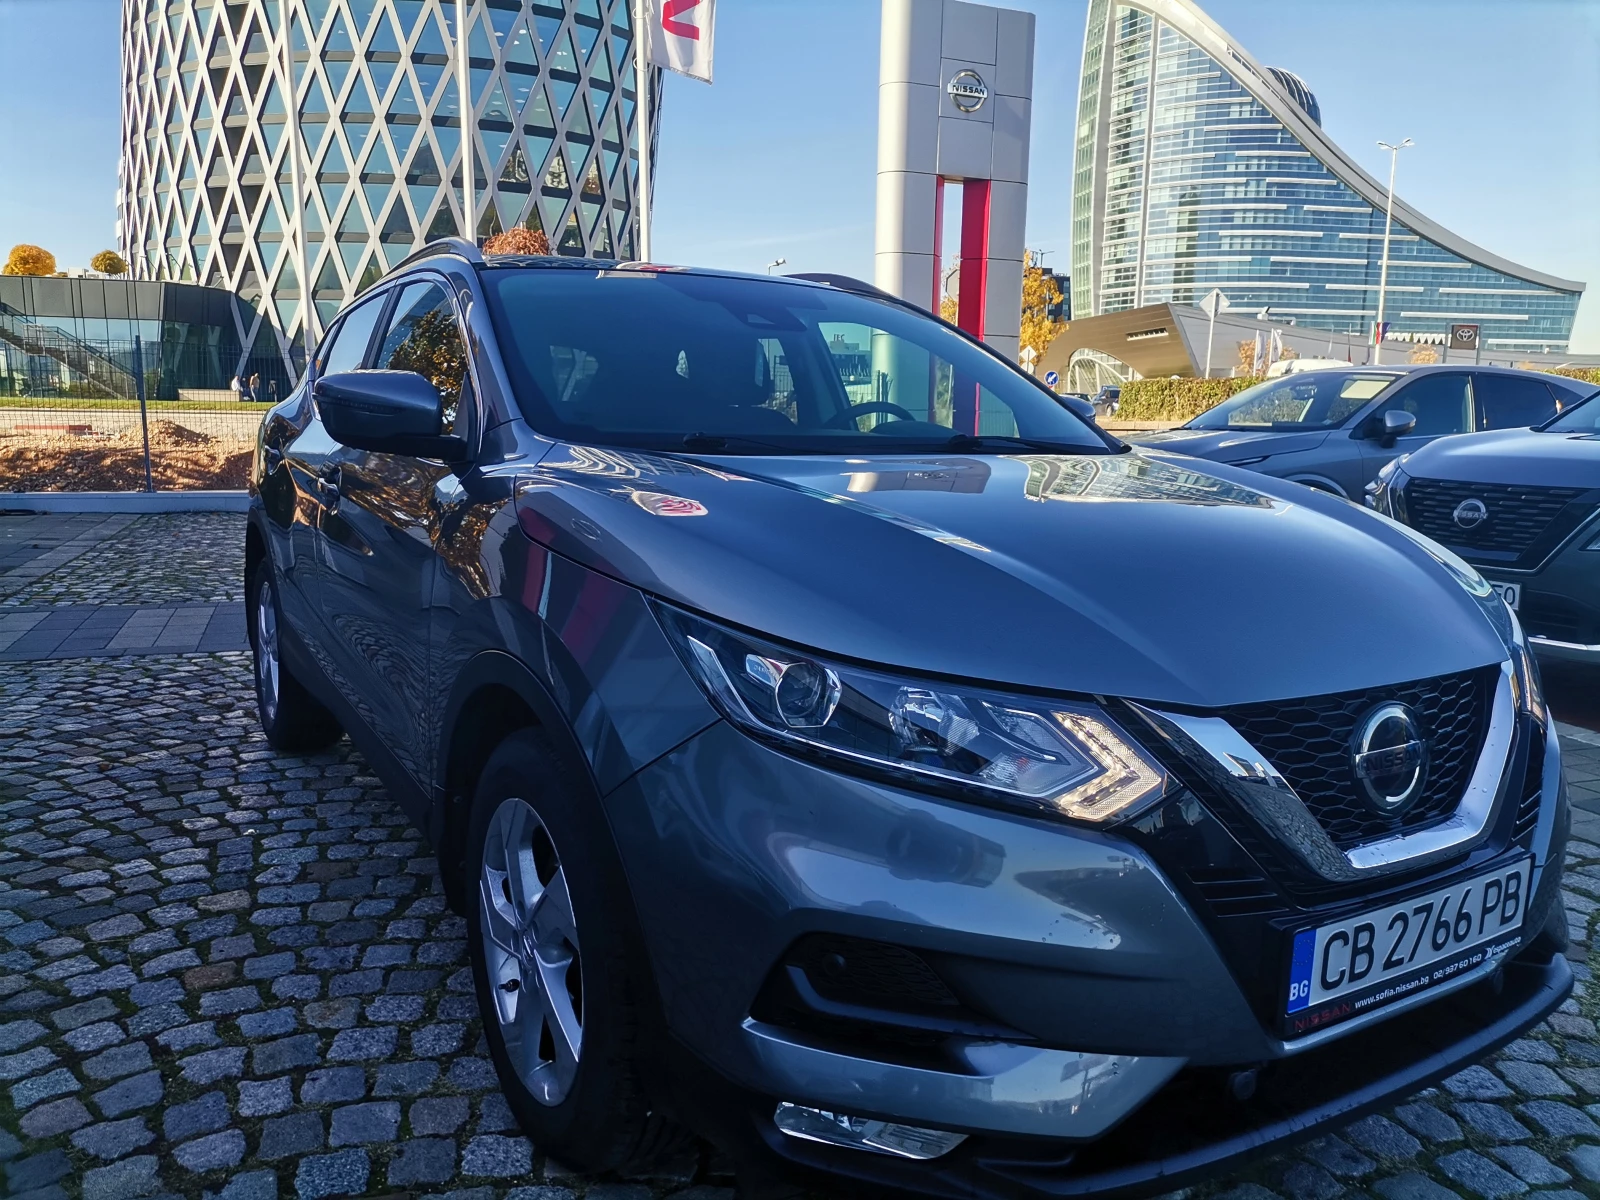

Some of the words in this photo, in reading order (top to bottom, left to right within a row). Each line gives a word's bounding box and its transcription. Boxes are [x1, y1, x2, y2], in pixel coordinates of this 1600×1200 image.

[952, 84, 985, 96] NISSAN
[1453, 509, 1488, 519] NISSAN
[1366, 746, 1420, 772] NISSAN
[1320, 921, 1376, 991] CB
[1382, 887, 1472, 972] 2766
[1478, 870, 1521, 935] PB
[1289, 980, 1309, 1001] BG
[1294, 1000, 1351, 1032] NISSAN
[1354, 975, 1429, 1010] www.sofia.nissan.bg
[1433, 963, 1458, 980] 02/937
